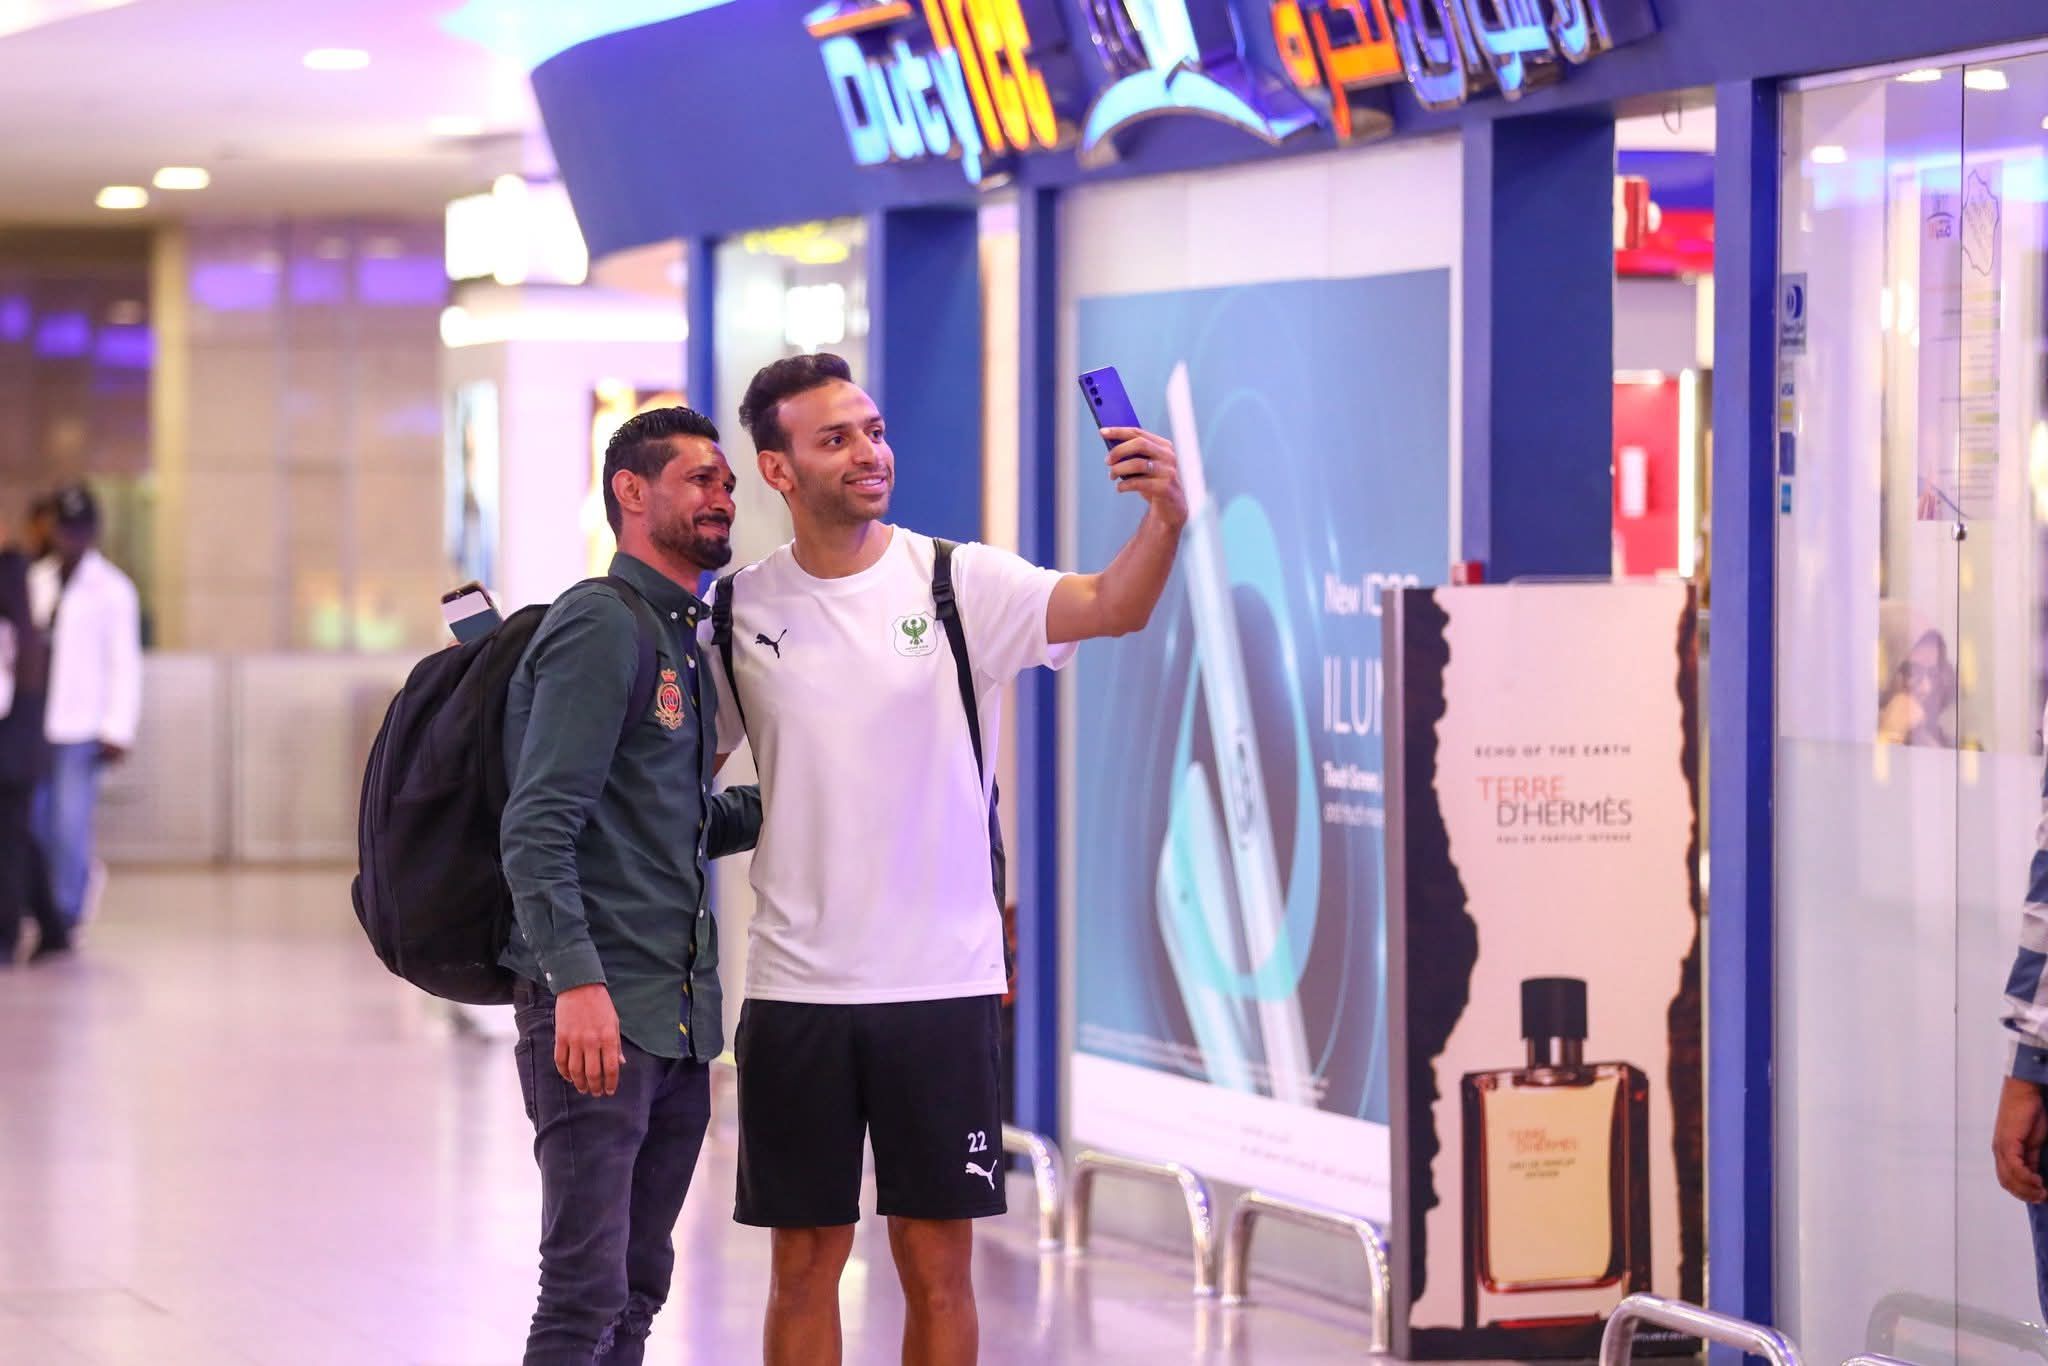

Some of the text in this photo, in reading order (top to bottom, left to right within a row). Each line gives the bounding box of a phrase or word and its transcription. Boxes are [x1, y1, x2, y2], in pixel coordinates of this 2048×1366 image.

[1323, 573, 1360, 615] New
[1522, 744, 1542, 758] OF
[1550, 743, 1576, 757] THE
[1583, 743, 1632, 756] EARTH
[1475, 774, 1567, 801] TERRE
[1496, 796, 1633, 827] D'HERMÈS
[967, 1130, 988, 1153] 22
